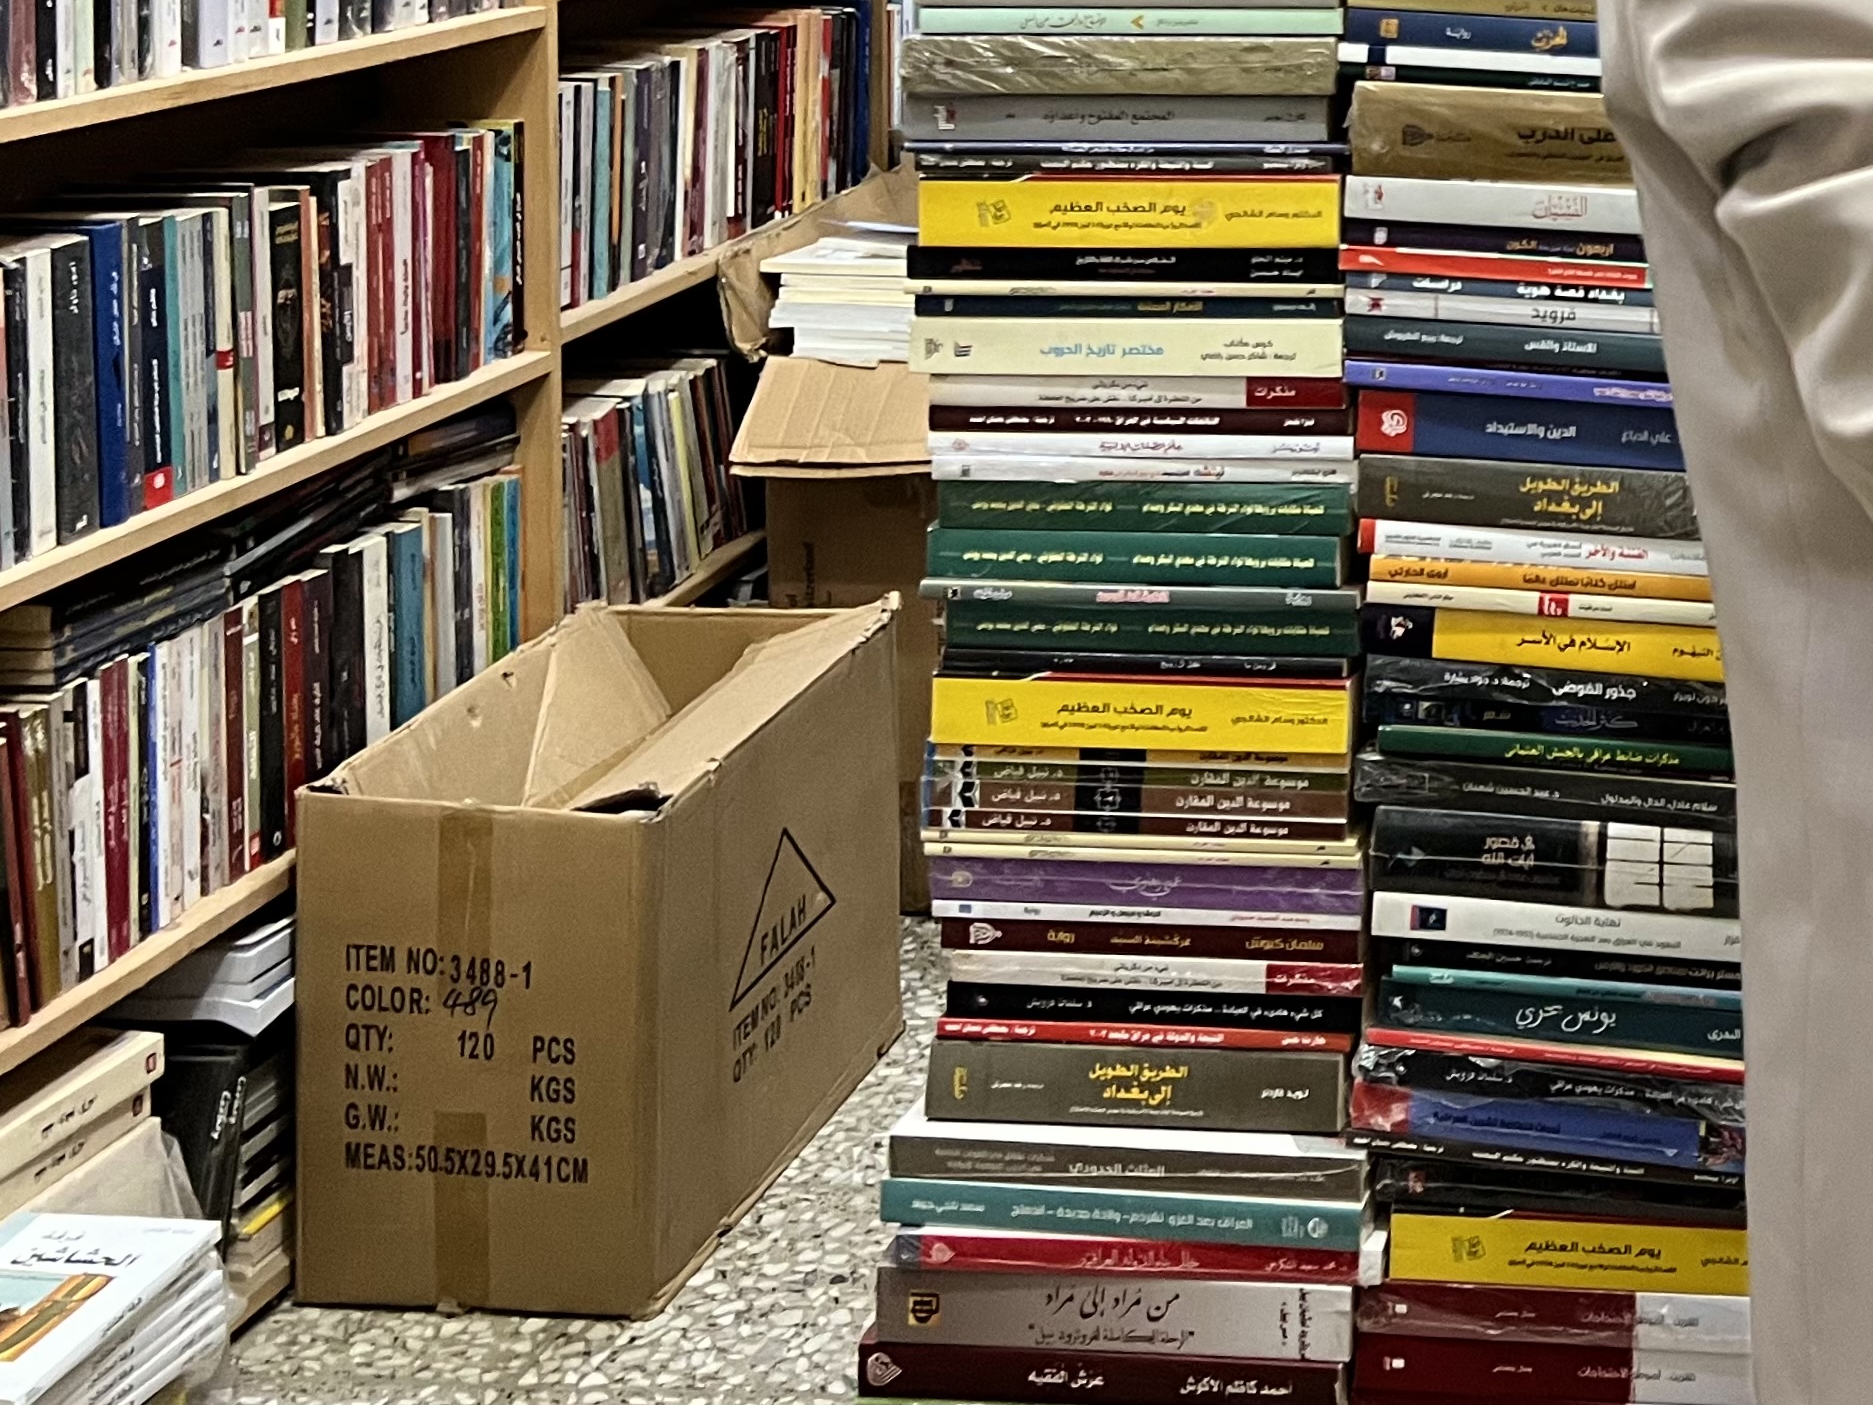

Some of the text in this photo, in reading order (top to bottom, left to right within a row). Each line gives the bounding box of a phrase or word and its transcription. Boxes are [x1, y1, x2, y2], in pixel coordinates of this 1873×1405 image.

[1517, 127, 1575, 145] الدرب
[1049, 200, 1186, 216] يوم الصخب العظيم
[1517, 282, 1551, 298] هوية
[1588, 287, 1625, 302] بغداد
[1531, 307, 1576, 322] فرويد
[1039, 342, 1164, 359] مختصر تاريخ الحروب
[1486, 421, 1576, 439] الدين والاستبداد
[1519, 477, 1619, 495] الطريق الطويل
[1534, 499, 1578, 516] بغداد
[1552, 678, 1636, 700] جذور الفوضى
[1056, 701, 1192, 718] يوم الصخب العظيم
[1024, 789, 1047, 803] نبيل
[1176, 796, 1216, 810] المقارن
[1246, 801, 1291, 812] موسوعة
[1016, 815, 1037, 827] نبيل
[1186, 821, 1219, 834] المقارن
[1246, 825, 1288, 836] موسوعة
[759, 894, 808, 967] FALAH
[345, 943, 396, 974] ITEM
[345, 983, 431, 1016] COLOR:
[789, 988, 813, 1023] PCS
[732, 1006, 762, 1049] ITEM
[1561, 1010, 1616, 1034] يونس
[345, 1025, 577, 1065] QTY: 120 PCS
[1089, 1063, 1189, 1080] الطريق الطويل
[530, 1075, 577, 1105] KGS
[1102, 1081, 1145, 1103] بغداد
[530, 1115, 577, 1145] KGS
[1525, 1241, 1661, 1260] يوم الصخب العظيم
